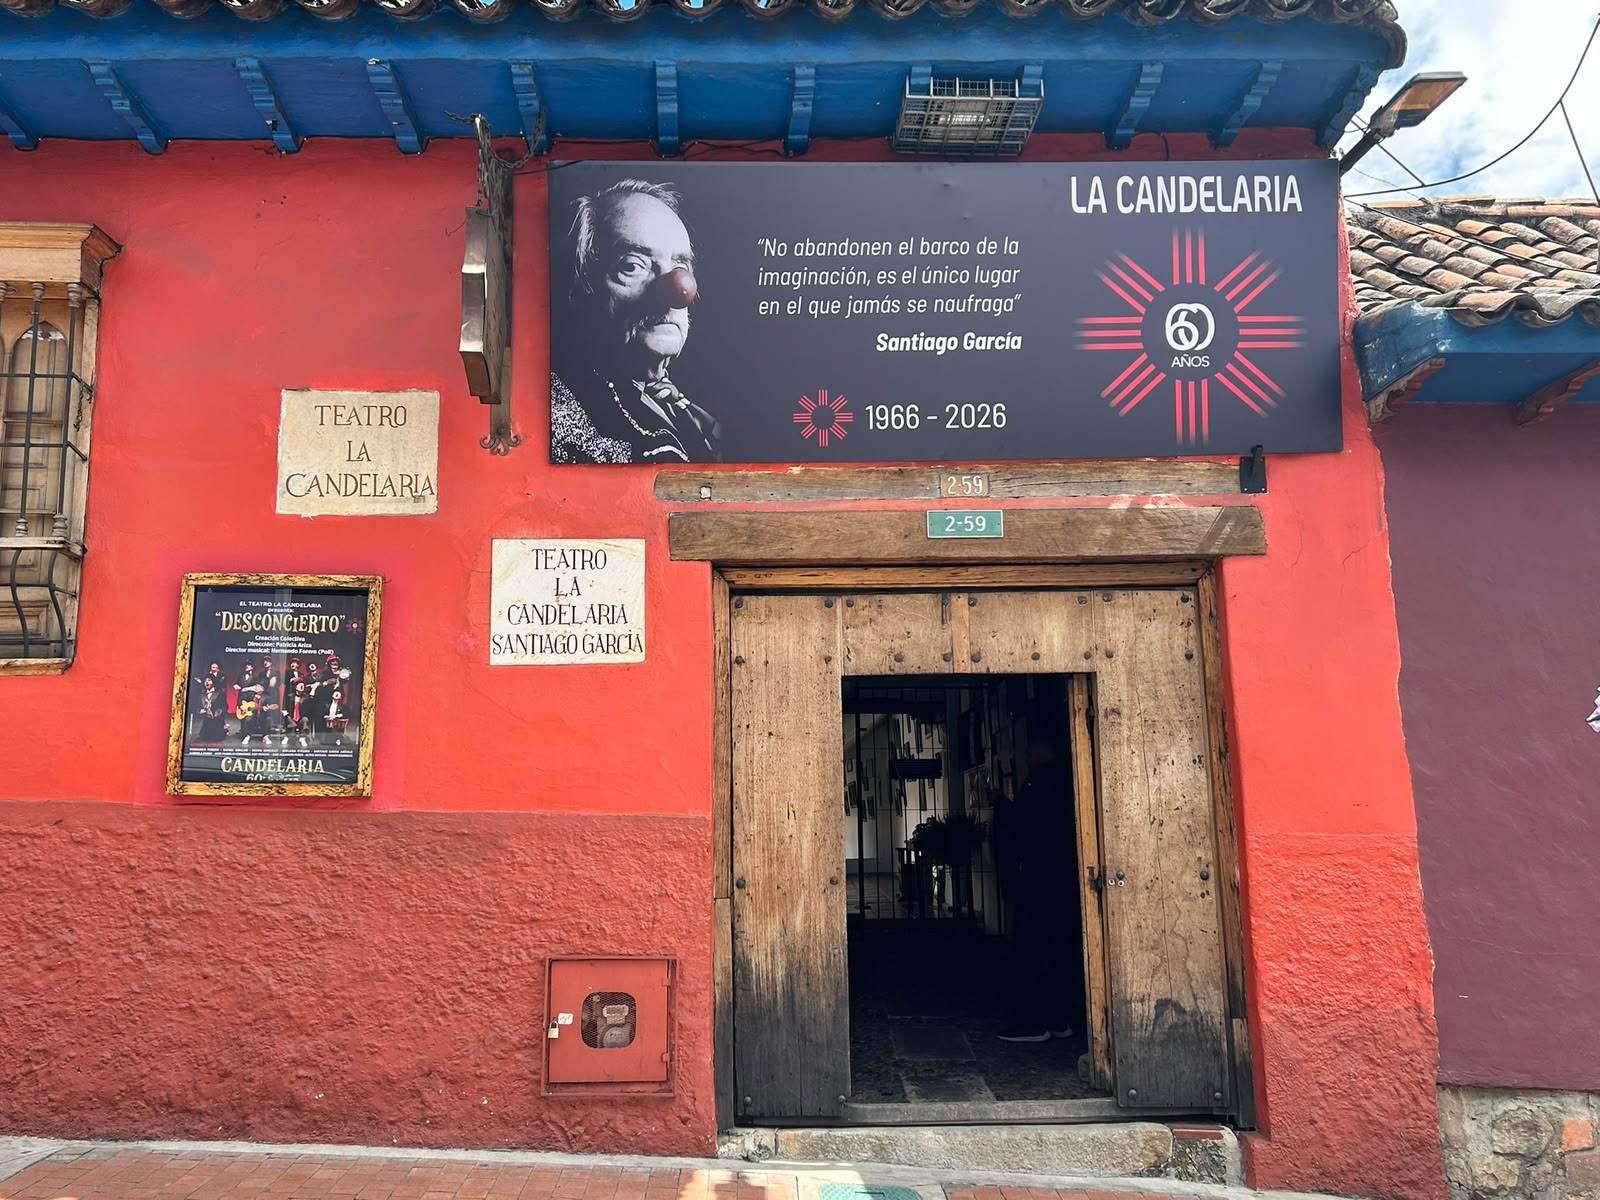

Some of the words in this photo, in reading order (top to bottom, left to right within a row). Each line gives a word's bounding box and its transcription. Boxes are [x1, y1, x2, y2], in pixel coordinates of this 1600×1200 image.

[1071, 175, 1108, 214] LA
[1116, 174, 1303, 214] CANDELARIA
[757, 238, 788, 257] “No
[794, 238, 892, 256] abandonen
[899, 237, 914, 255] el
[920, 237, 970, 255] barco
[976, 236, 998, 255] de
[1003, 236, 1019, 255] la
[758, 266, 871, 290] imaginación,
[877, 270, 897, 285] es
[902, 266, 917, 284] el
[921, 265, 970, 284] único
[975, 265, 1020, 288] lugar
[759, 300, 780, 315] en
[787, 296, 802, 314] el
[808, 299, 841, 319] que
[844, 295, 901, 319] jamás
[907, 298, 927, 313] se
[934, 293, 1021, 317] naufraga”
[1165, 303, 1215, 351] 60
[876, 332, 958, 356] Santiago
[963, 331, 1022, 351] García
[1171, 353, 1210, 368] AÑOS
[314, 405, 407, 428] TEATRO
[865, 404, 920, 430] 1966
[945, 403, 1007, 429] 2026
[346, 440, 372, 462] LA
[285, 473, 435, 499] CANDELARIA
[944, 516, 986, 532] 2-59
[532, 548, 607, 570] TEATRO
[554, 576, 582, 597] LA
[507, 603, 629, 626] CANDELARIA
[492, 633, 578, 656] SANTIAGO
[220, 757, 325, 774] CANDELARIA
